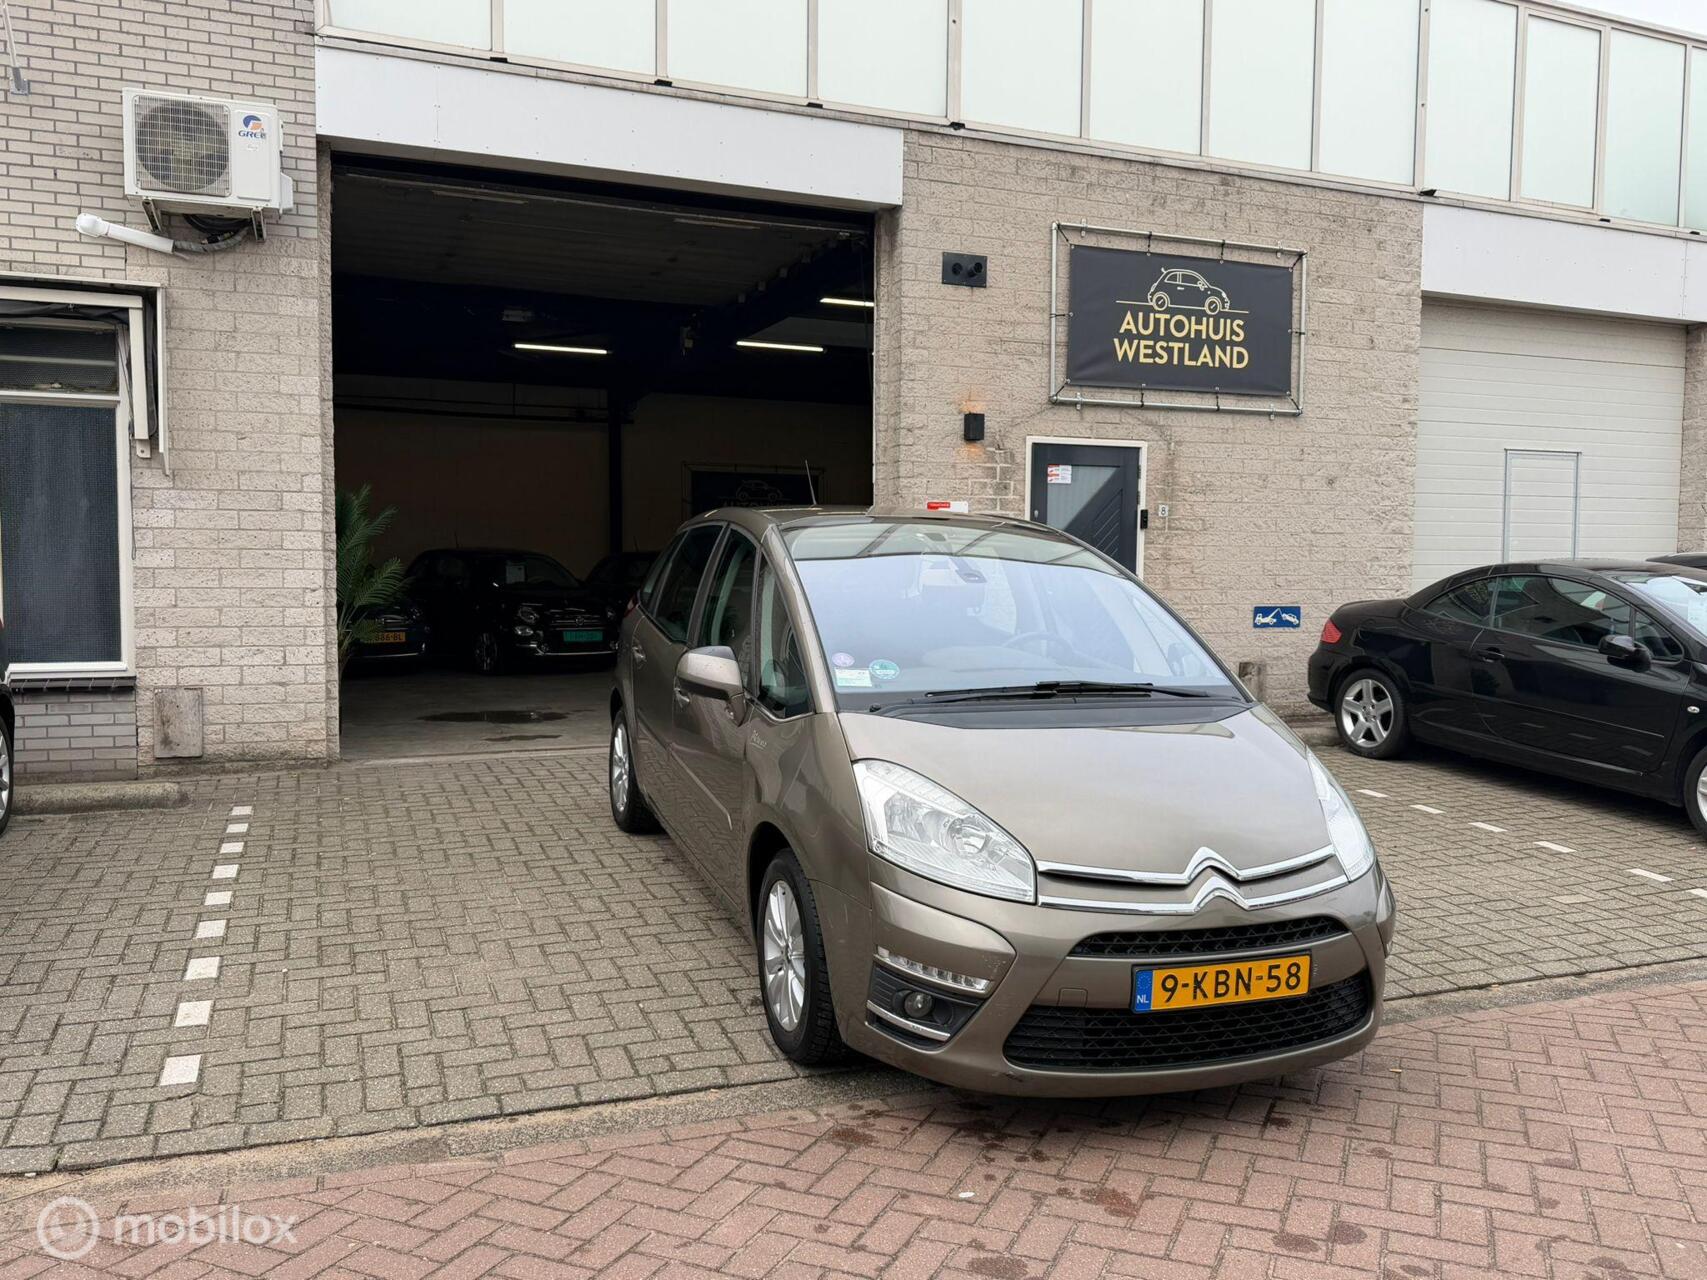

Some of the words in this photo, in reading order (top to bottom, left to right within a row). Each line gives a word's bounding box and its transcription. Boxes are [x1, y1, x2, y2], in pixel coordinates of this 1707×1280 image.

[1119, 310, 1245, 342] AUTOHUIS
[1113, 338, 1249, 369] WESTLAND
[1160, 506, 1167, 516] 8
[1136, 995, 1149, 1004] NL
[1160, 962, 1302, 1004] 9-KBN-58
